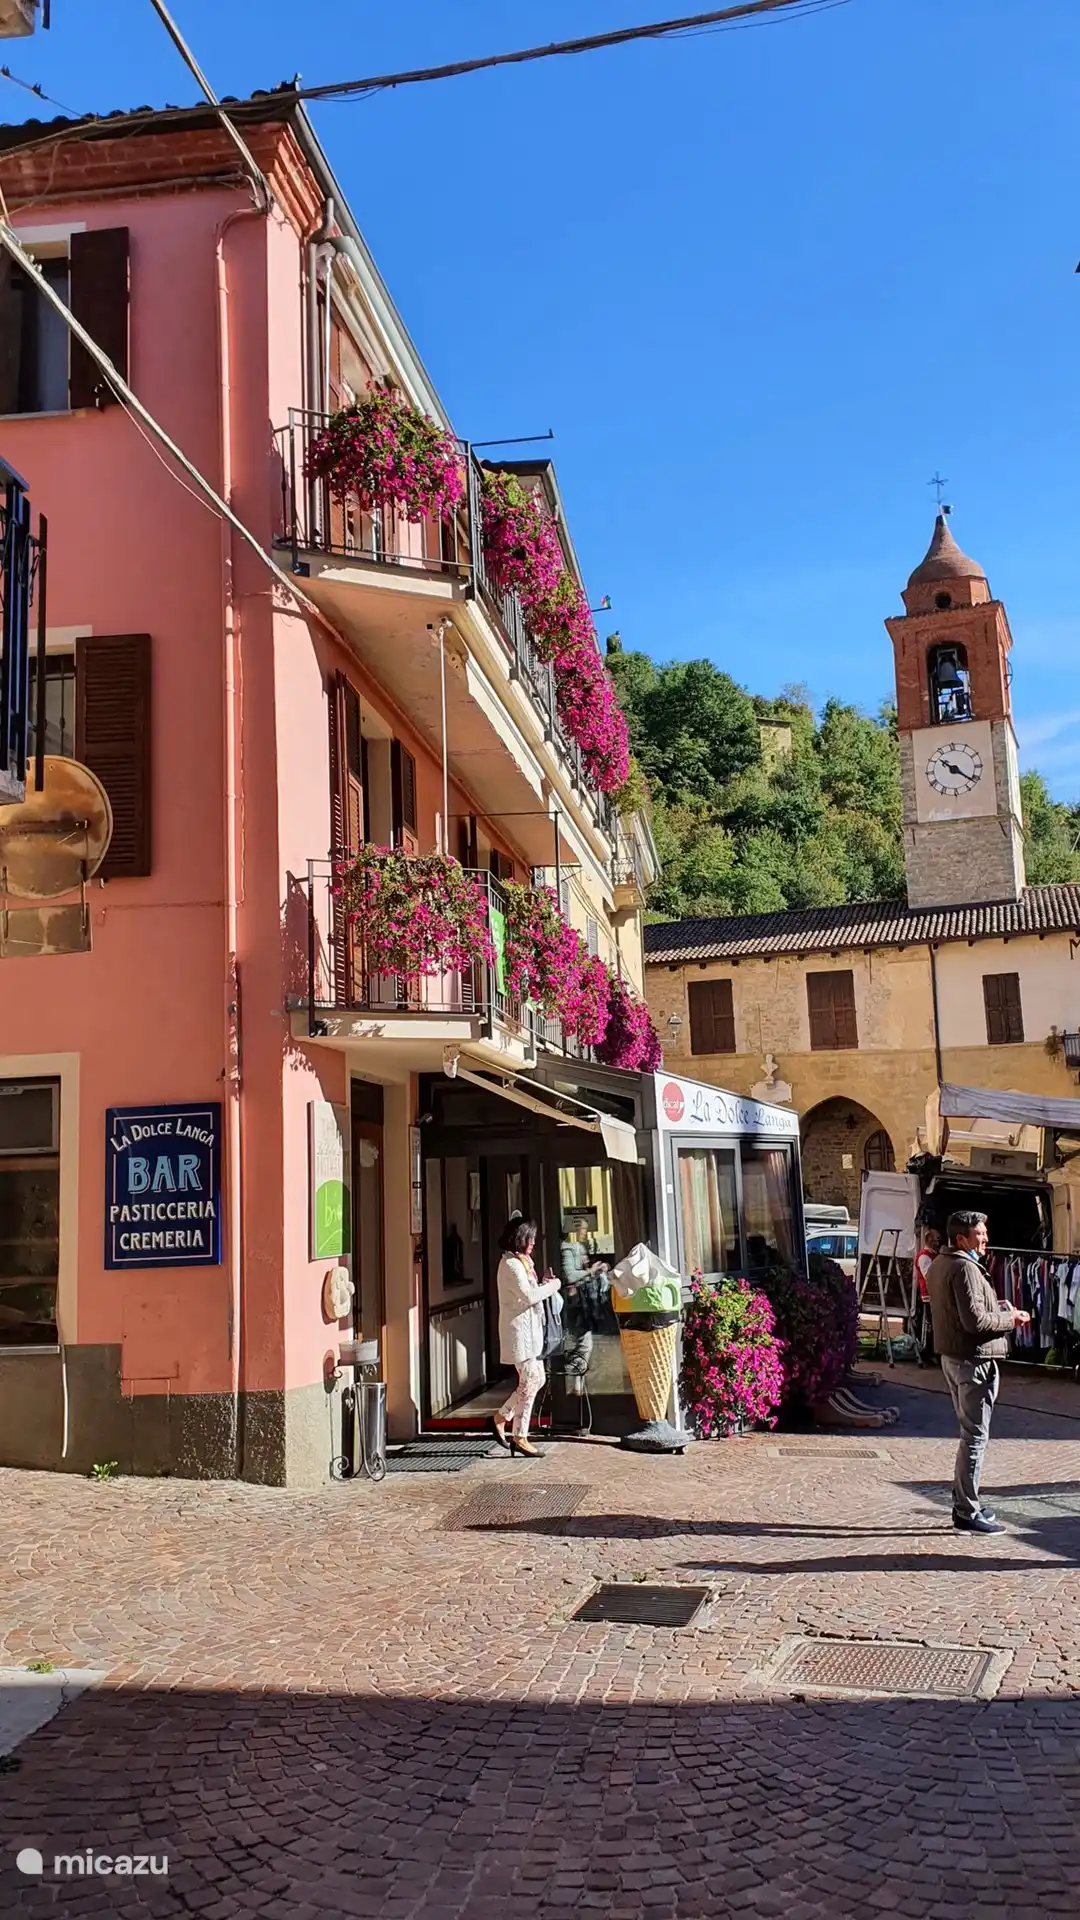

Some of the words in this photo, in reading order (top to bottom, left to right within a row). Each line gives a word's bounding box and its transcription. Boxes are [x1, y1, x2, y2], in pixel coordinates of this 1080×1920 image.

[690, 1090, 711, 1123] La
[714, 1095, 749, 1124] Dolce
[753, 1108, 792, 1131] Langa
[128, 1154, 203, 1194] BAR
[109, 1200, 216, 1223] PASTICCERIA
[119, 1229, 204, 1251] CREMERIA
